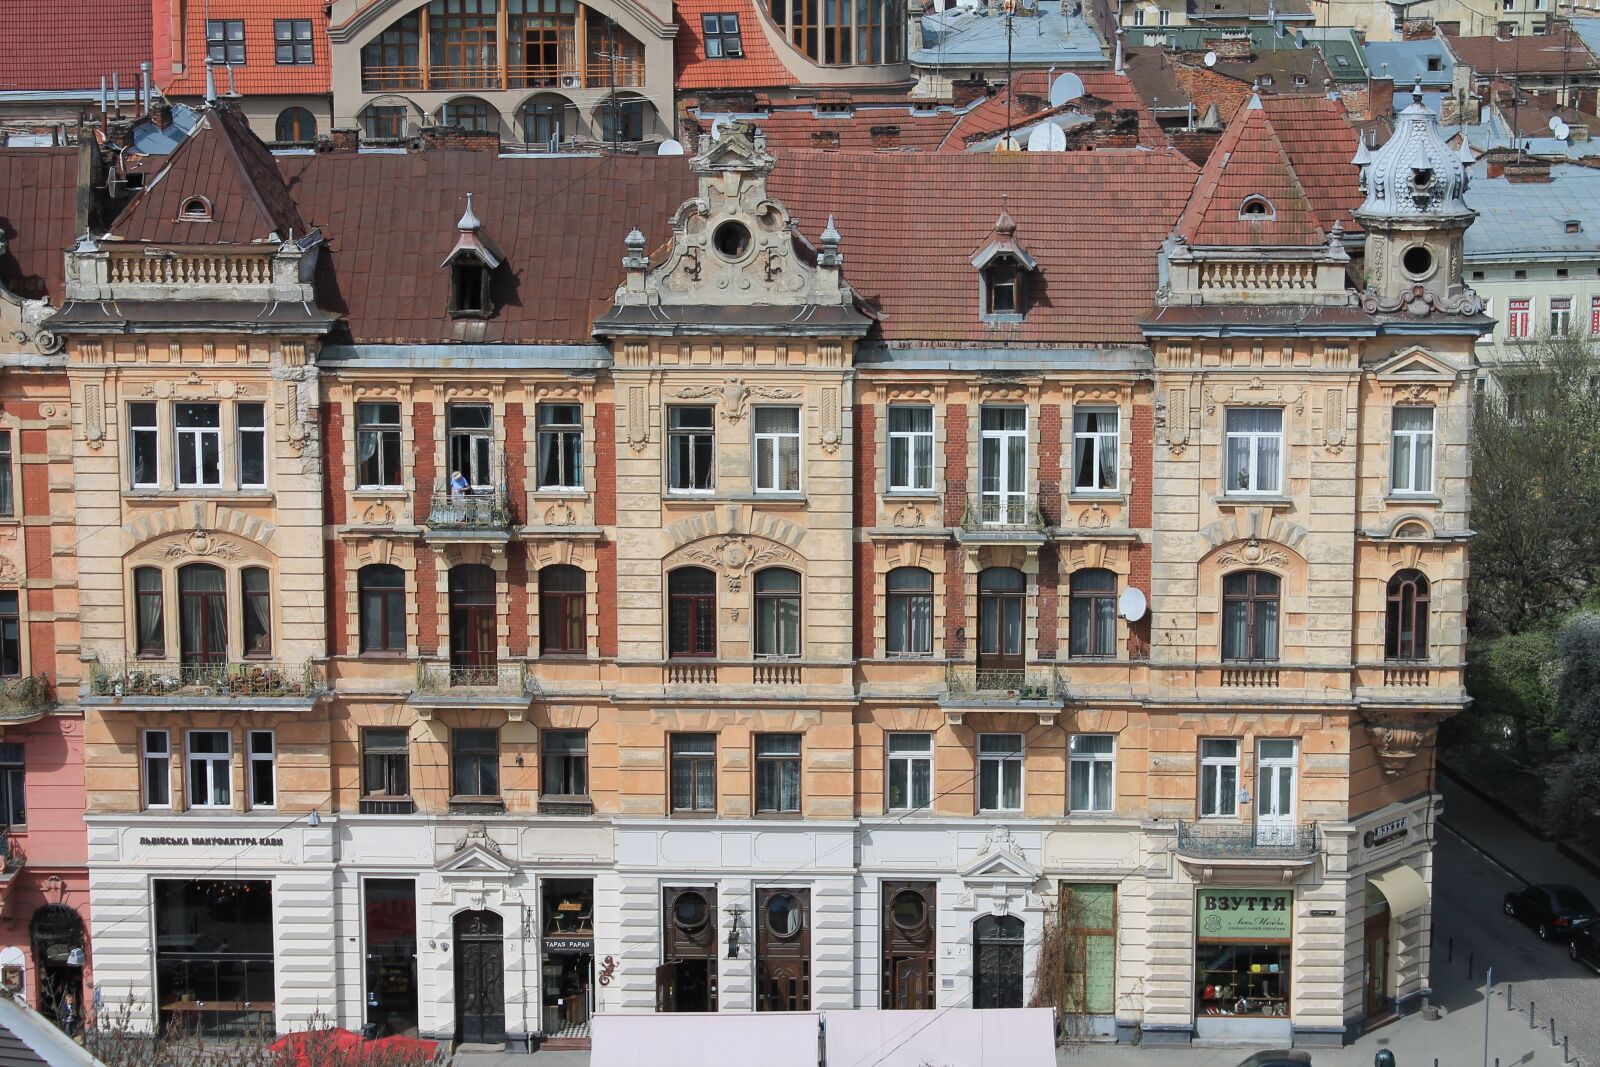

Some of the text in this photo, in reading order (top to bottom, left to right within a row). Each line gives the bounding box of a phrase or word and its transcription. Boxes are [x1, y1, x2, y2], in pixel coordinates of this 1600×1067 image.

[1375, 816, 1408, 836] ВЗУТТЯ
[139, 837, 284, 847] ЛЬВІВСЬКА МАНУФАКТУРА КАВИ
[1204, 896, 1286, 911] ВЗУТТЯ
